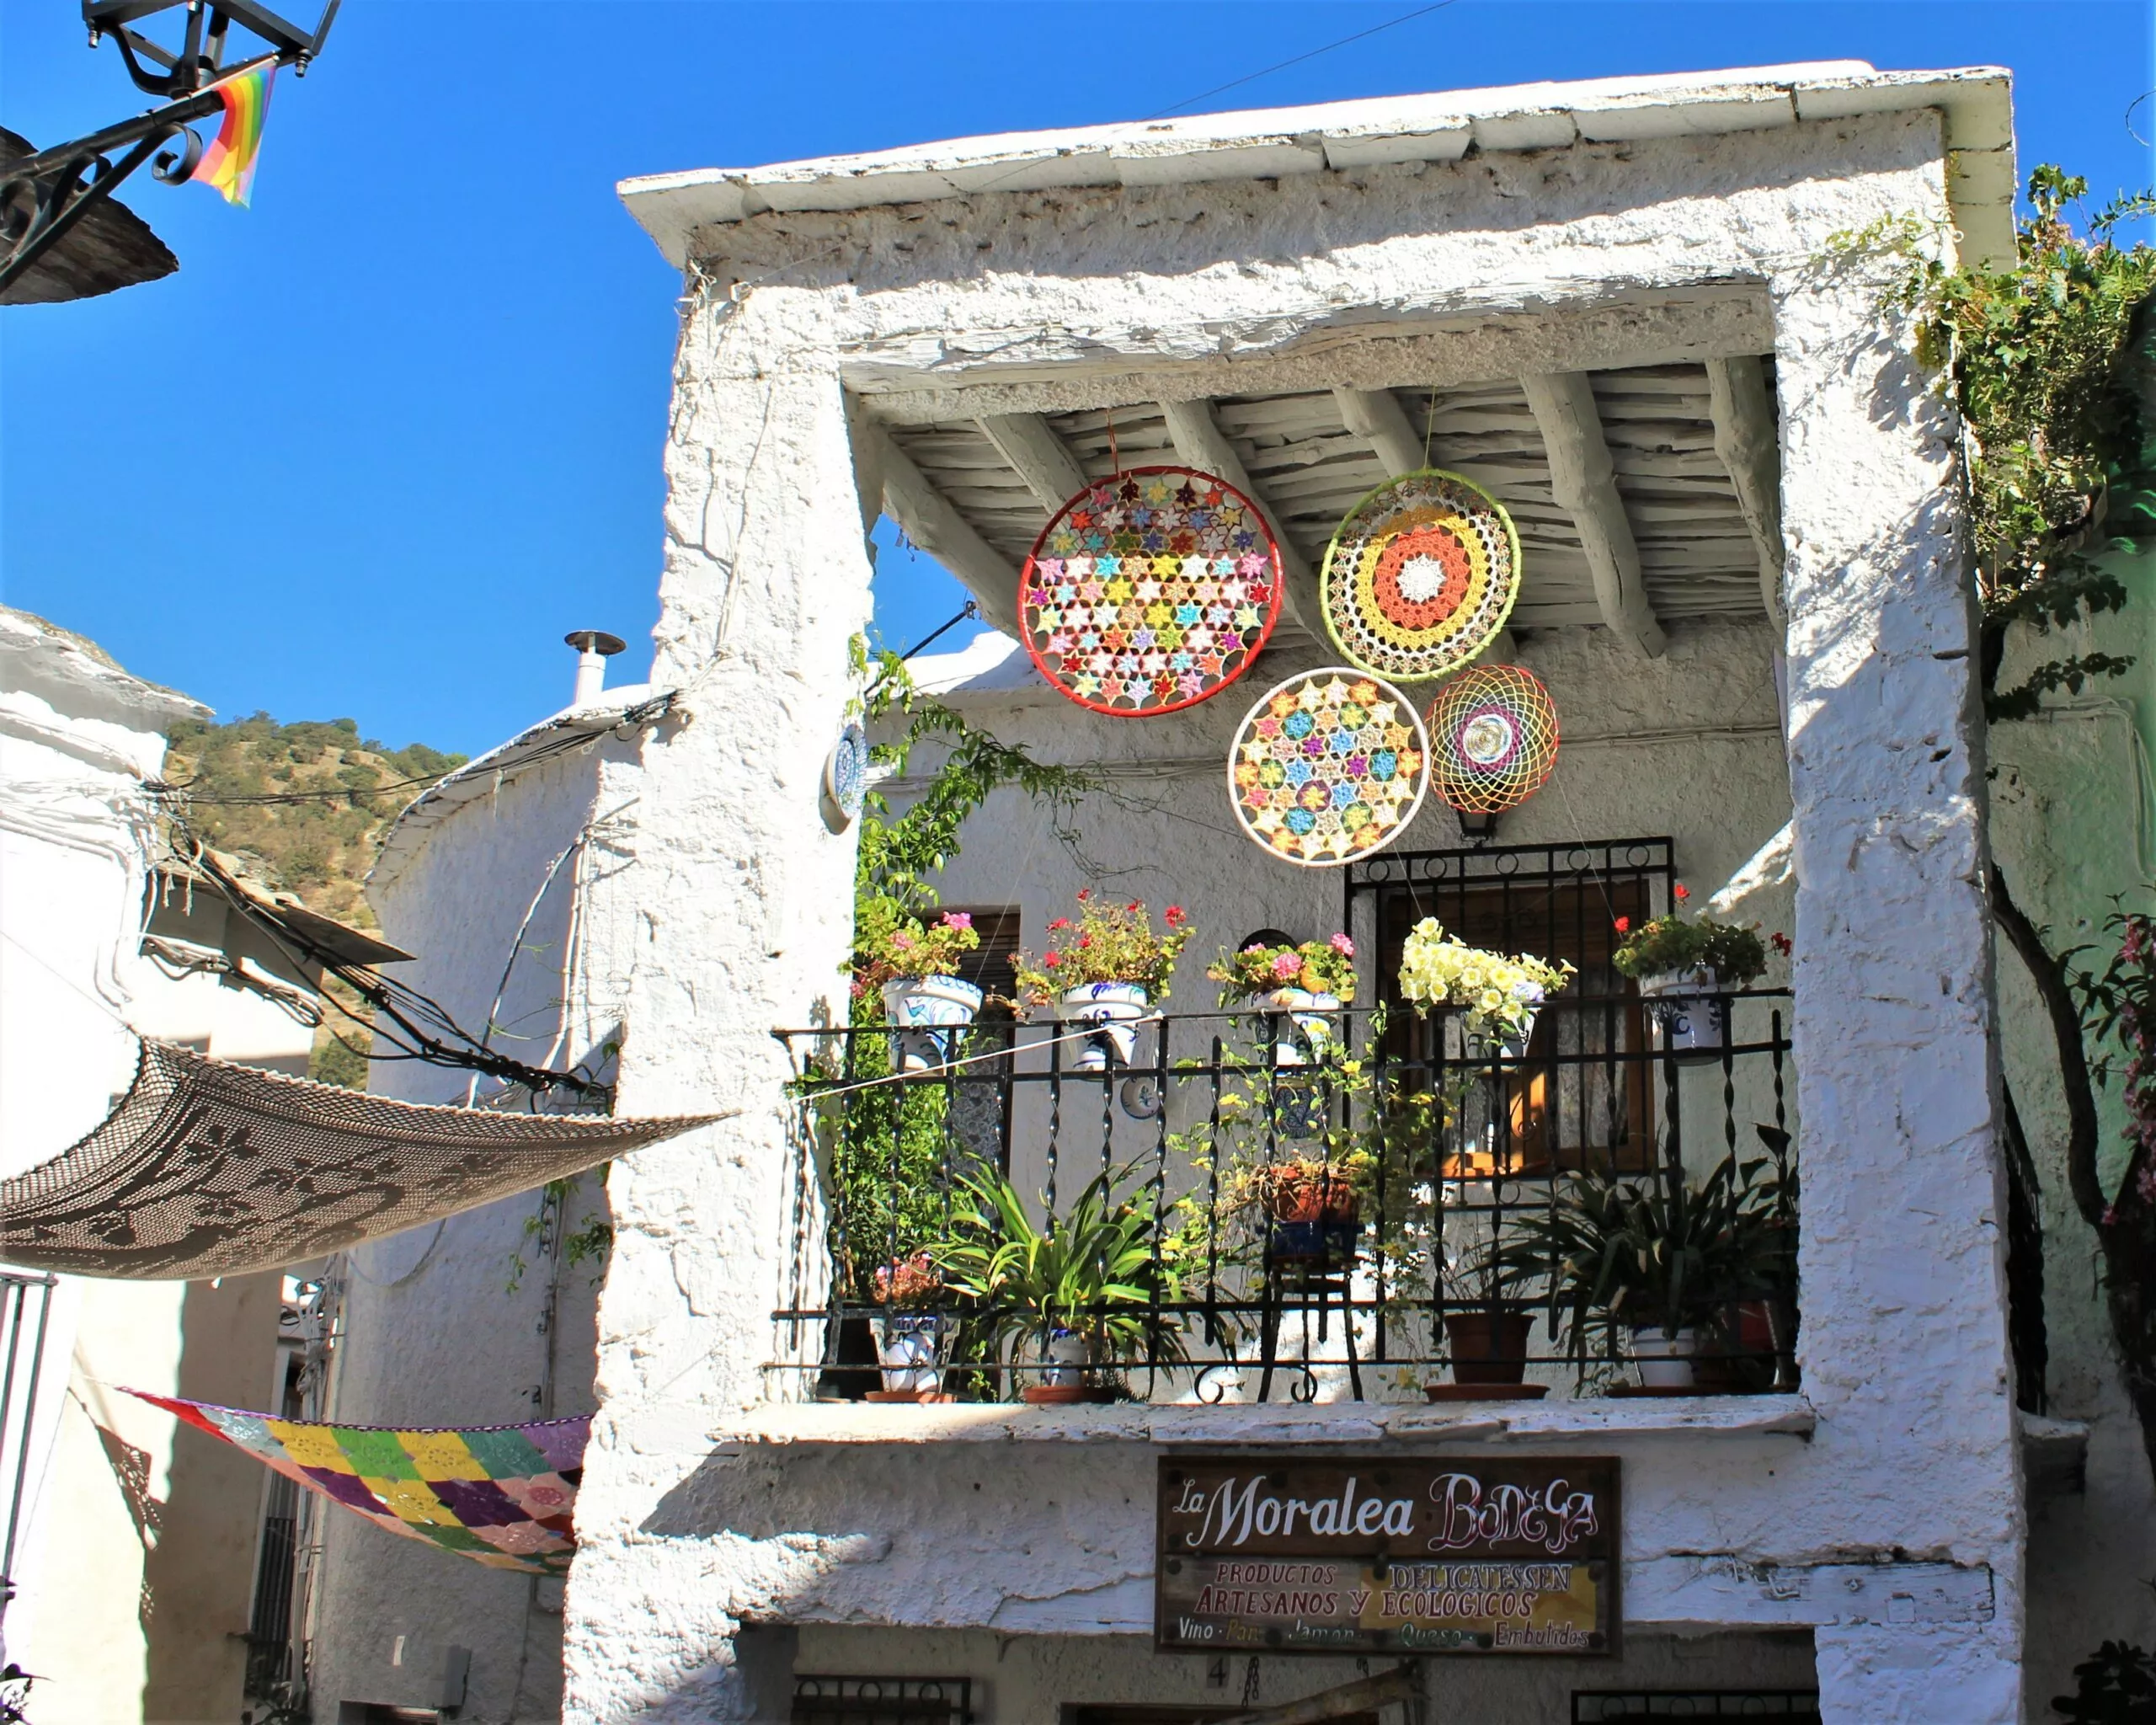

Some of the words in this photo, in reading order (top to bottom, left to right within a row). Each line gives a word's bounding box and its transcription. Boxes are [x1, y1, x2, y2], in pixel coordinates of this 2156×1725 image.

[1172, 1478, 1206, 1514] La
[1186, 1476, 1415, 1546] Moralea
[1214, 1563, 1337, 1584] PRODUCTOS
[1389, 1563, 1572, 1591] DELICATESSEN
[1193, 1583, 1338, 1616] ARTESANOS
[1178, 1616, 1214, 1640] Vino
[1225, 1617, 1259, 1642] Pan
[1400, 1621, 1462, 1648] Queso
[1493, 1619, 1590, 1647] Embutidos
[1209, 1656, 1226, 1687] 4
